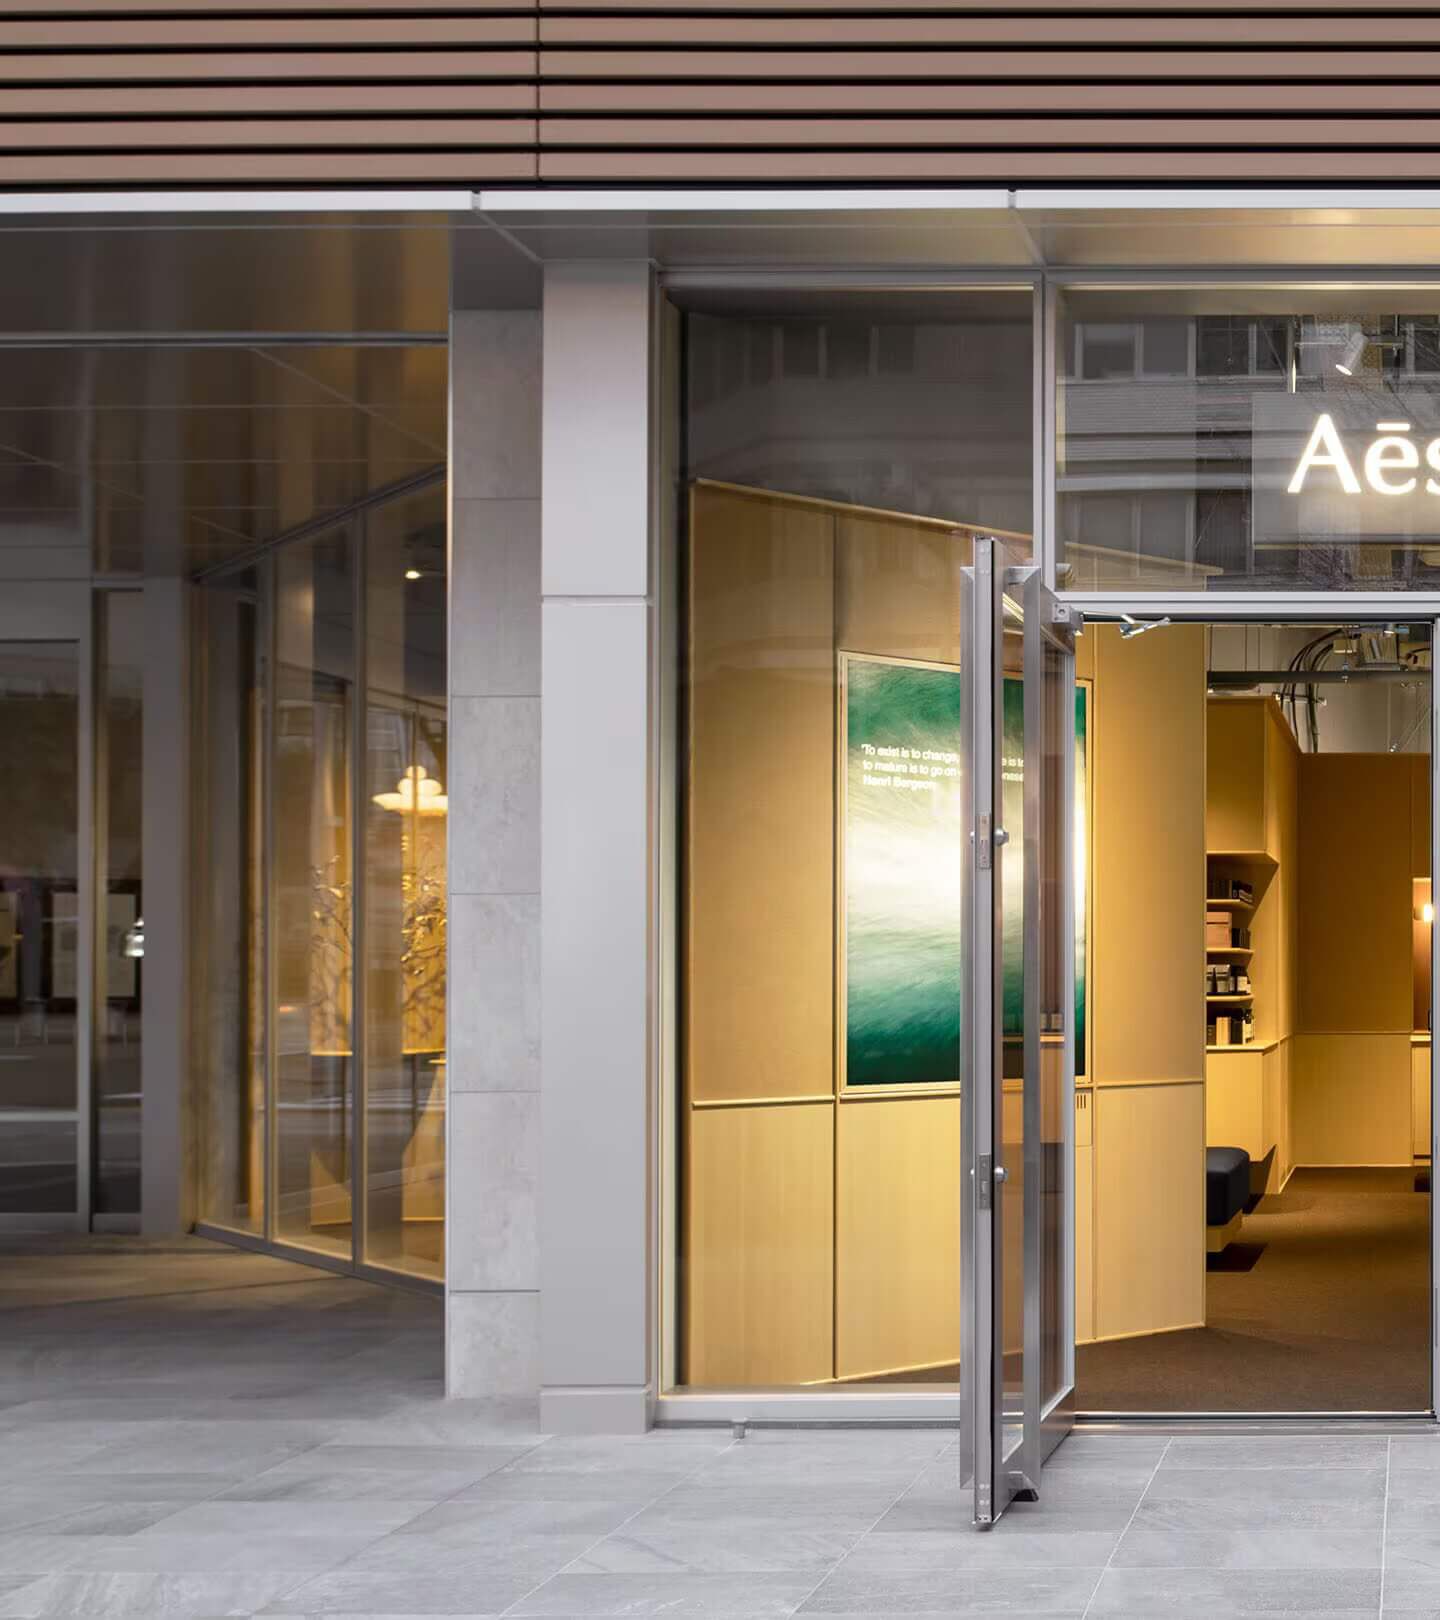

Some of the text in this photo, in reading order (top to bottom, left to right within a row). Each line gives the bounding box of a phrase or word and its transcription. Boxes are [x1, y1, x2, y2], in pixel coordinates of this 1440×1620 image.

[877, 745, 899, 757] exist
[901, 747, 910, 758] is
[912, 748, 921, 759] to
[862, 759, 873, 770] to
[909, 763, 918, 774] is
[919, 764, 929, 774] to
[930, 766, 943, 777] go
[944, 767, 956, 777] on
[864, 774, 891, 786] Henri
